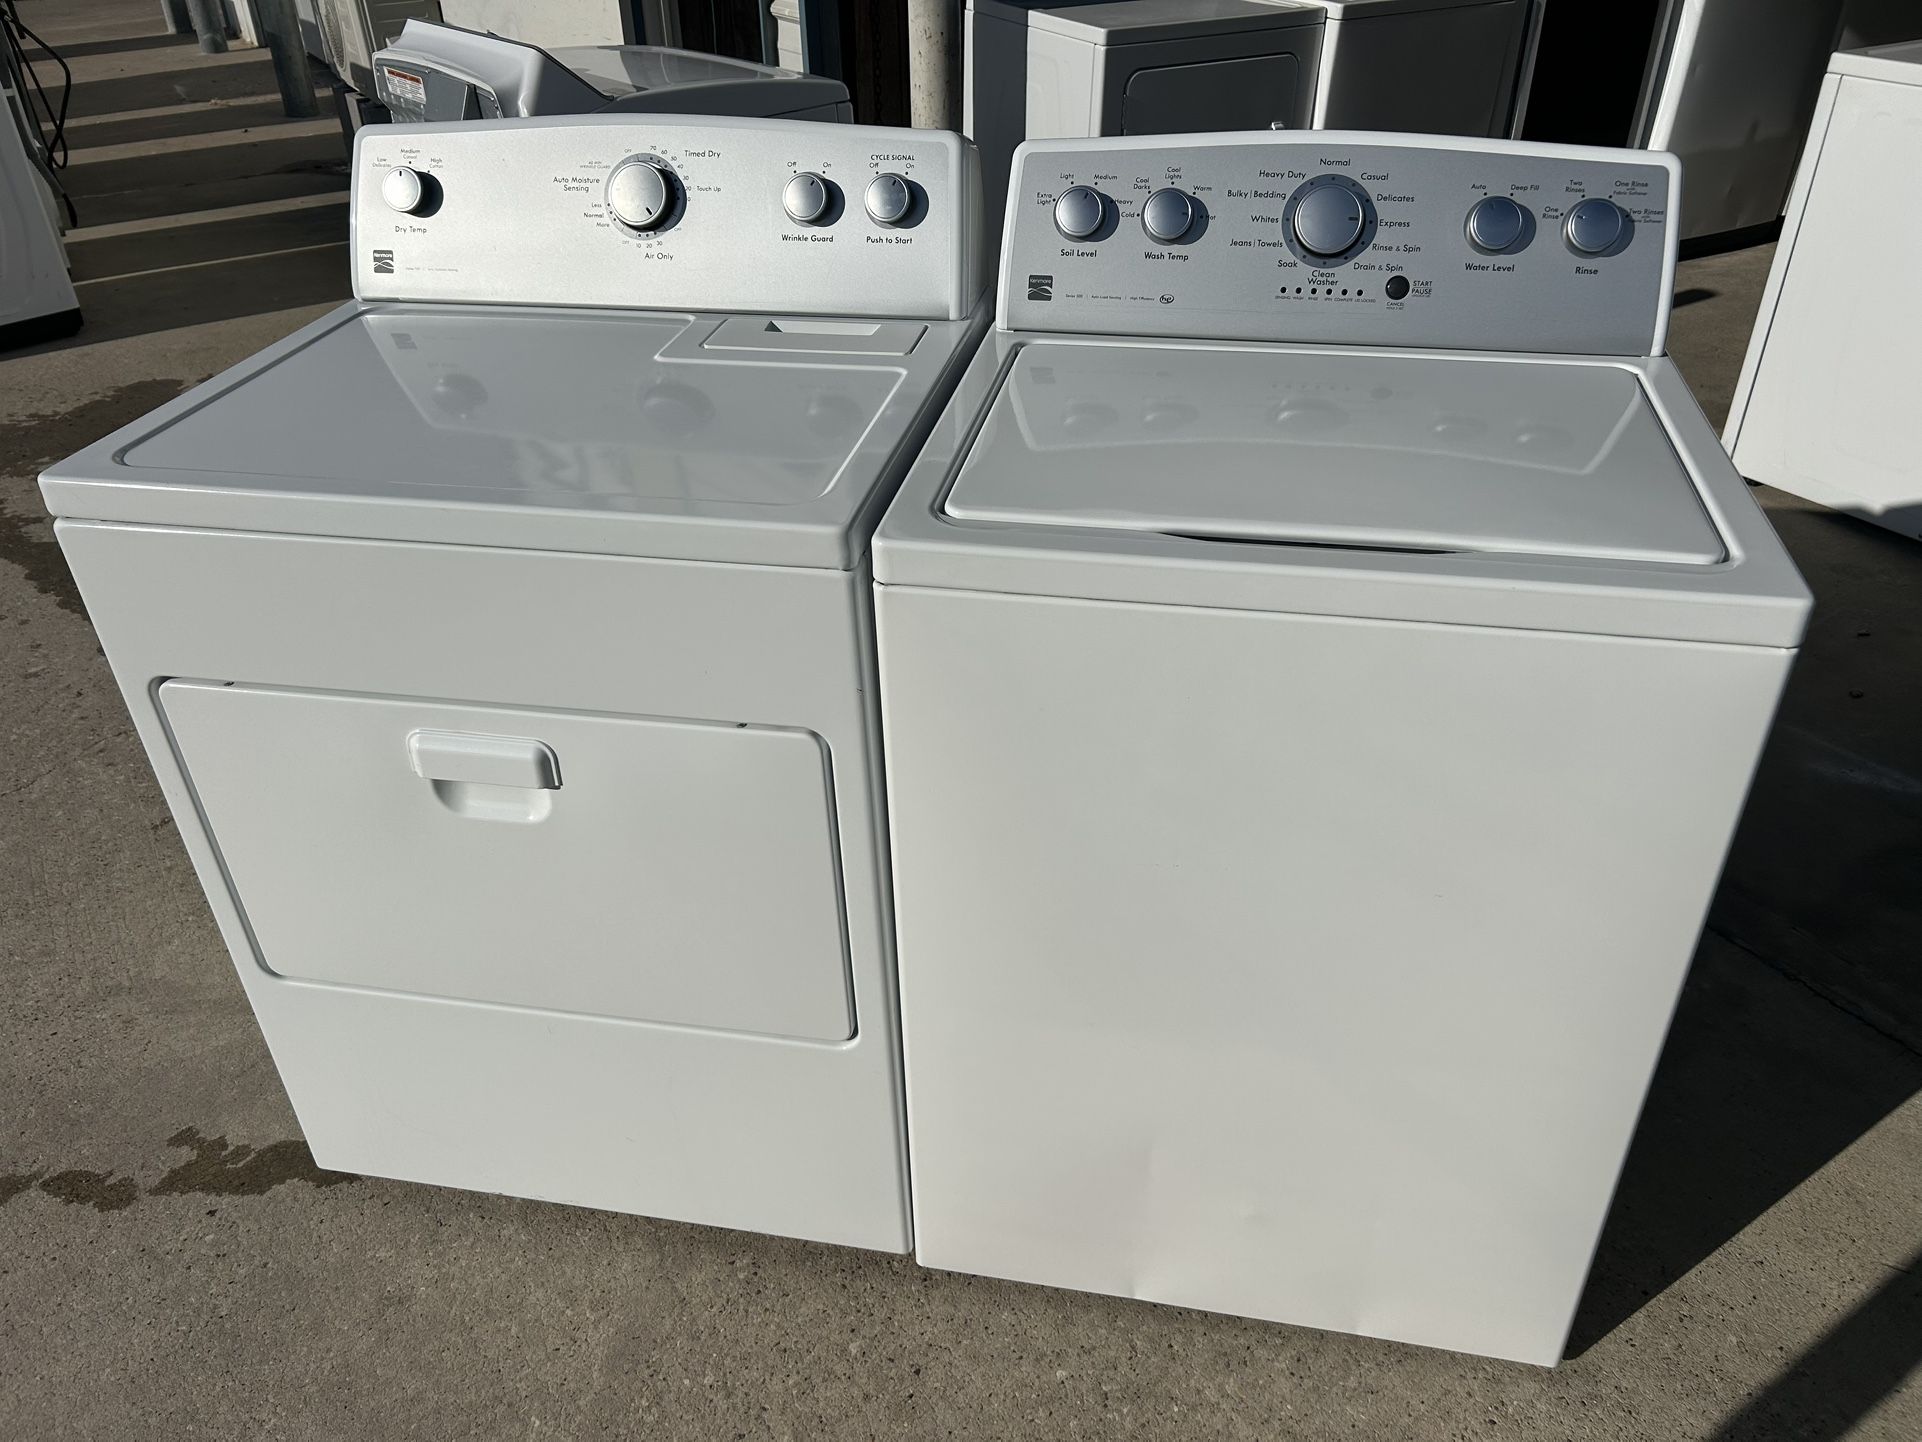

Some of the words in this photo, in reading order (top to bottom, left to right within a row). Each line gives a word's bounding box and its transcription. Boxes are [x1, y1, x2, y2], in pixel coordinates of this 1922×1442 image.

[1259, 170, 1284, 179] Heavy
[1287, 171, 1306, 180] Duty
[1227, 190, 1248, 199] Bulky
[1254, 191, 1286, 200] Bedding
[1377, 194, 1414, 202] Delicates
[1380, 219, 1410, 228] Express
[395, 226, 407, 234] Dry
[1060, 249, 1074, 257] Soil
[1077, 249, 1097, 258] Level
[1403, 245, 1421, 254] Spin
[1168, 253, 1188, 262] Temp
[1278, 260, 1298, 268] Soak
[1386, 264, 1403, 273] Spin
[1465, 263, 1489, 272] Water
[1492, 264, 1514, 272] Level
[1575, 267, 1598, 275] Rinse
[1308, 278, 1338, 286] Washer
